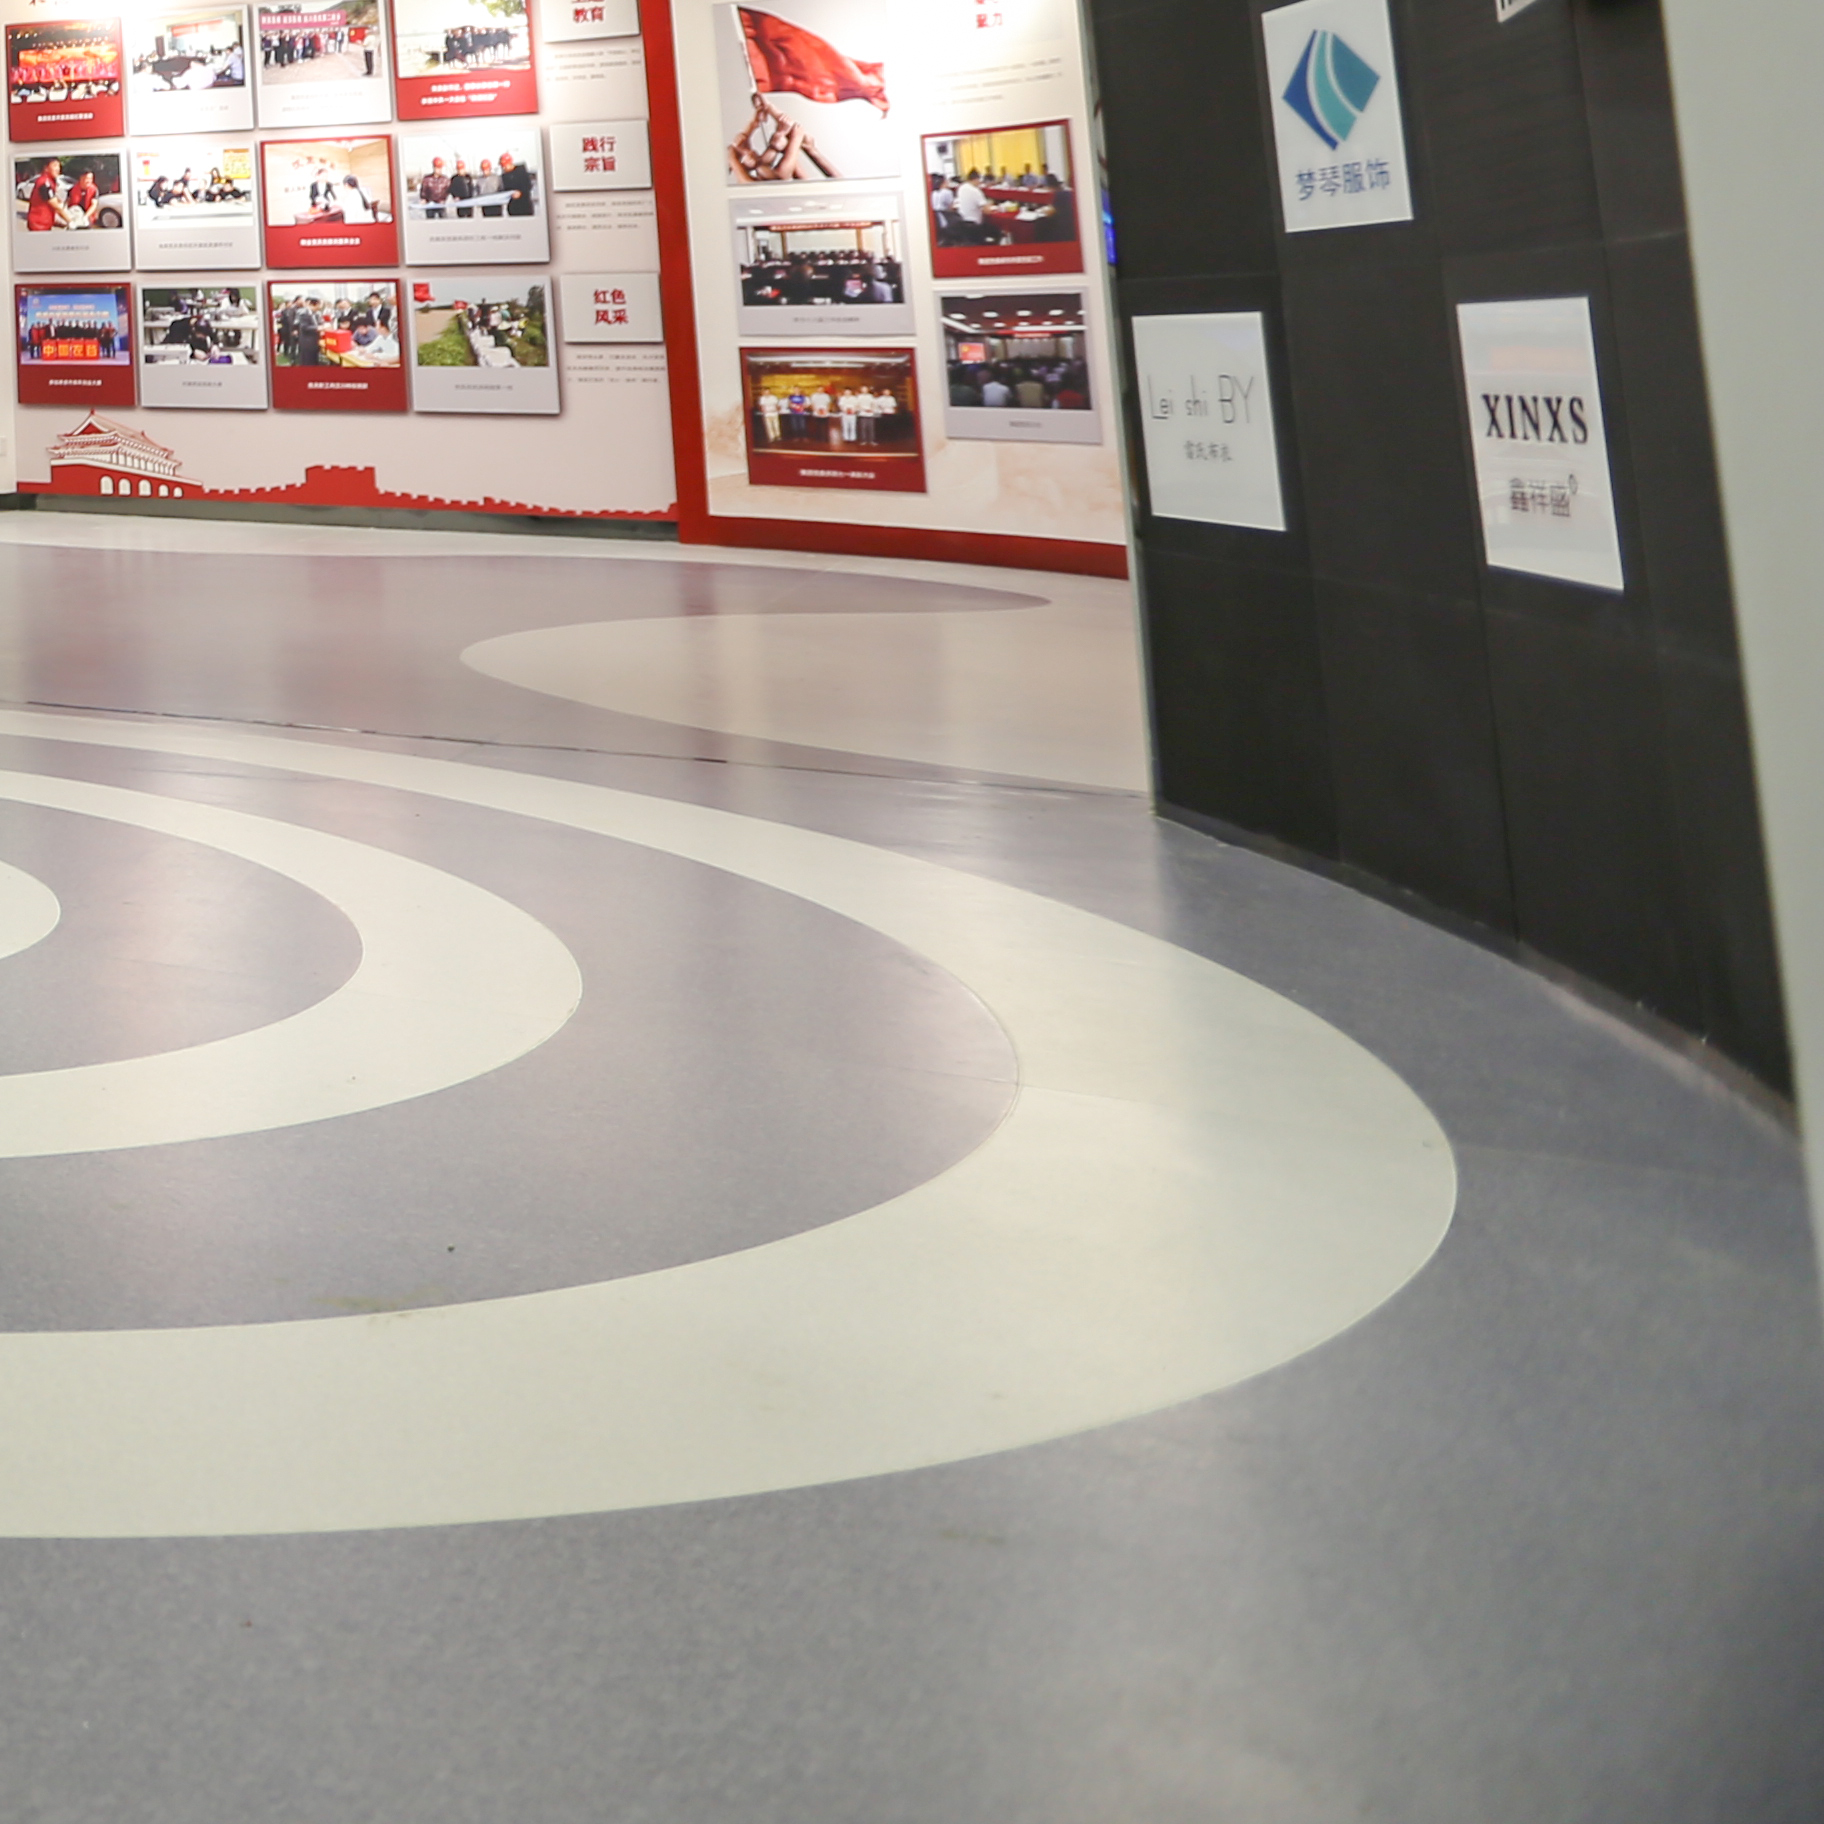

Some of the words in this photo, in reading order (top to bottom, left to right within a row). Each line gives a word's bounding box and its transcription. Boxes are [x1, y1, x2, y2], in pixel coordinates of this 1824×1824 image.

[572, 7, 605, 23] 教育
[582, 136, 617, 153] 践行
[583, 157, 617, 172] 宗旨
[1296, 160, 1391, 201] 梦琴服饰
[592, 287, 626, 306] 红色
[594, 308, 629, 327] 风采
[1482, 394, 1588, 444] XINXS
